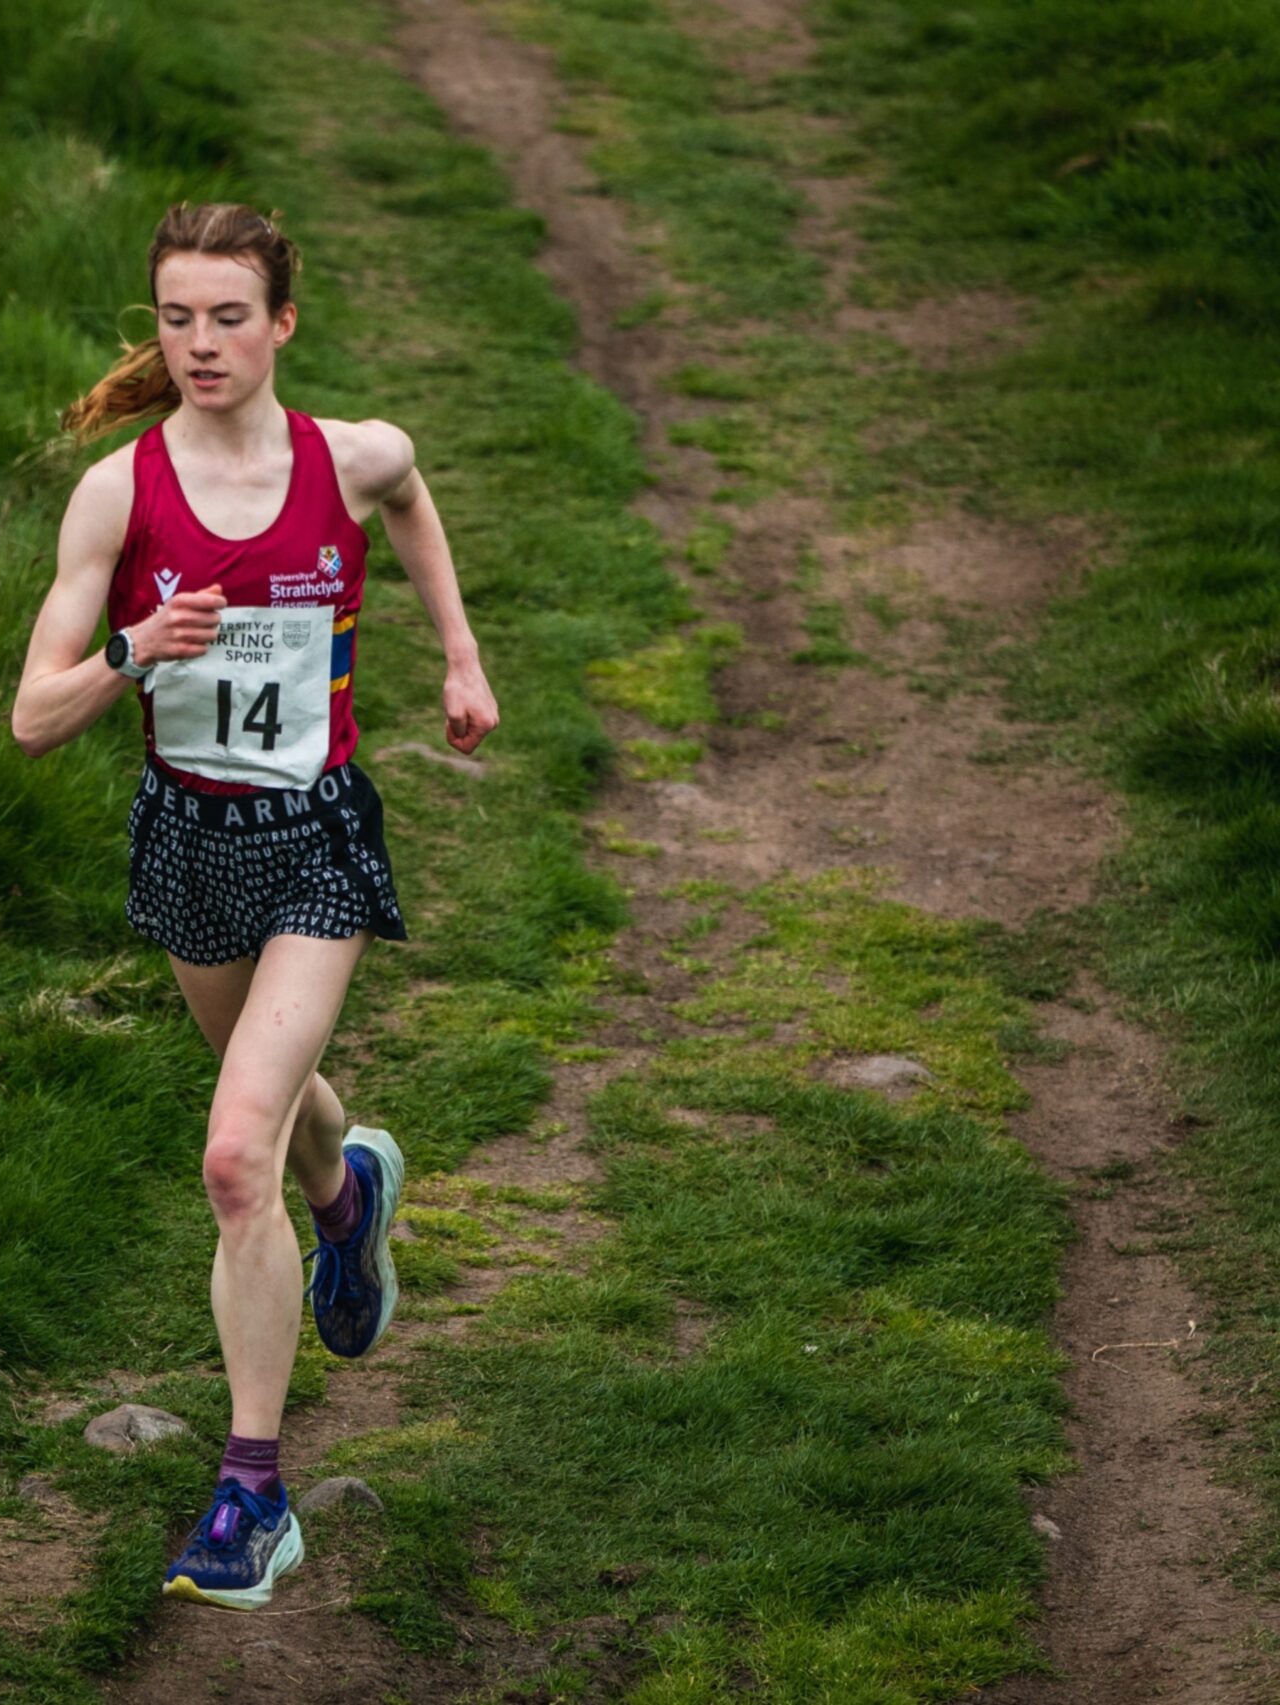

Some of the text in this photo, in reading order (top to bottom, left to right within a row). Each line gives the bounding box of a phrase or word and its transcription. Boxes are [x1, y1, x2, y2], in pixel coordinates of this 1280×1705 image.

[269, 573, 310, 584] University
[270, 578, 344, 598] Strathclyde
[220, 621, 275, 632] ERSITY of
[225, 650, 272, 664] SPORT
[216, 679, 282, 751] 14
[143, 764, 200, 821] DER
